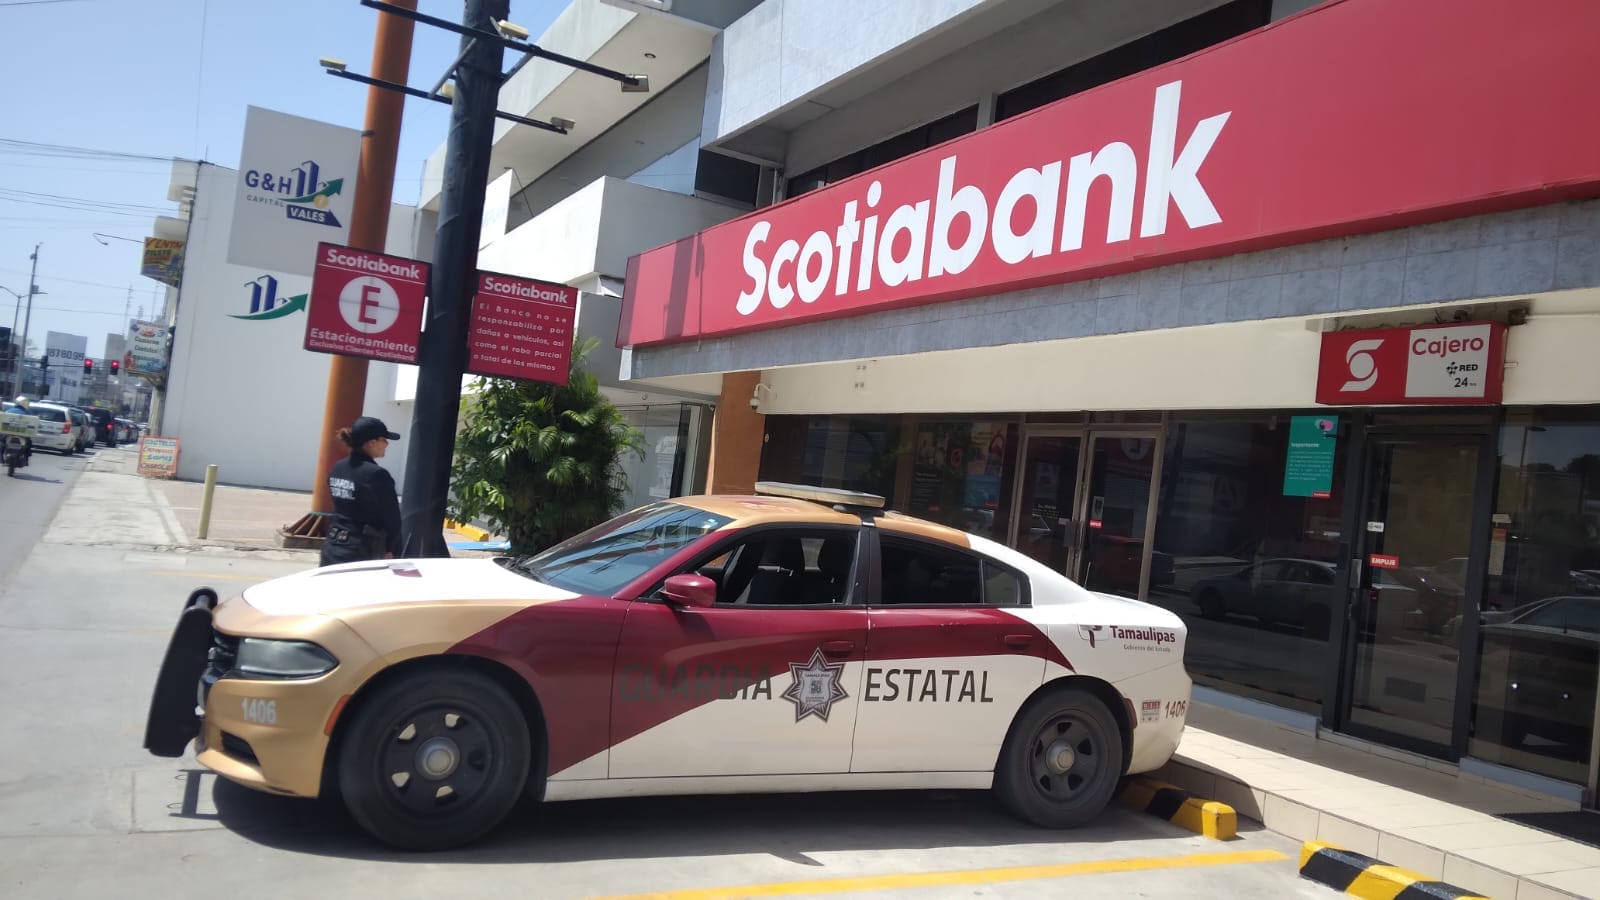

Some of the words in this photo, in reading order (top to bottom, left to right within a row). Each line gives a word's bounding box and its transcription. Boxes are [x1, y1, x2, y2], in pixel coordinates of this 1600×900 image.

[245, 169, 292, 195] G&H
[246, 194, 285, 207] CAPITAL
[736, 79, 1232, 315] Scotiabank
[290, 207, 325, 222] VALES
[326, 249, 420, 279] Scotiabank
[484, 277, 568, 303] Scotiabank
[358, 284, 381, 325] E
[479, 302, 490, 310] El
[496, 305, 531, 317] Banco
[536, 313, 550, 321] no
[310, 328, 417, 353] Estacionamiento
[476, 327, 501, 337] daños
[550, 327, 565, 335] por
[474, 341, 497, 349] como
[512, 346, 531, 355] robo
[534, 349, 562, 359] parcial
[1412, 336, 1484, 358] Cajero
[480, 354, 500, 363] total
[513, 359, 525, 367] los
[526, 361, 556, 371] mismos
[1454, 377, 1468, 388] 24
[1371, 557, 1396, 566] EMPUJE
[1109, 625, 1176, 645] Tamaulipas
[619, 663, 773, 702] GUARDIA
[864, 667, 994, 703] ESTATAL
[240, 697, 277, 724] 1406
[1165, 700, 1186, 719] 1406
